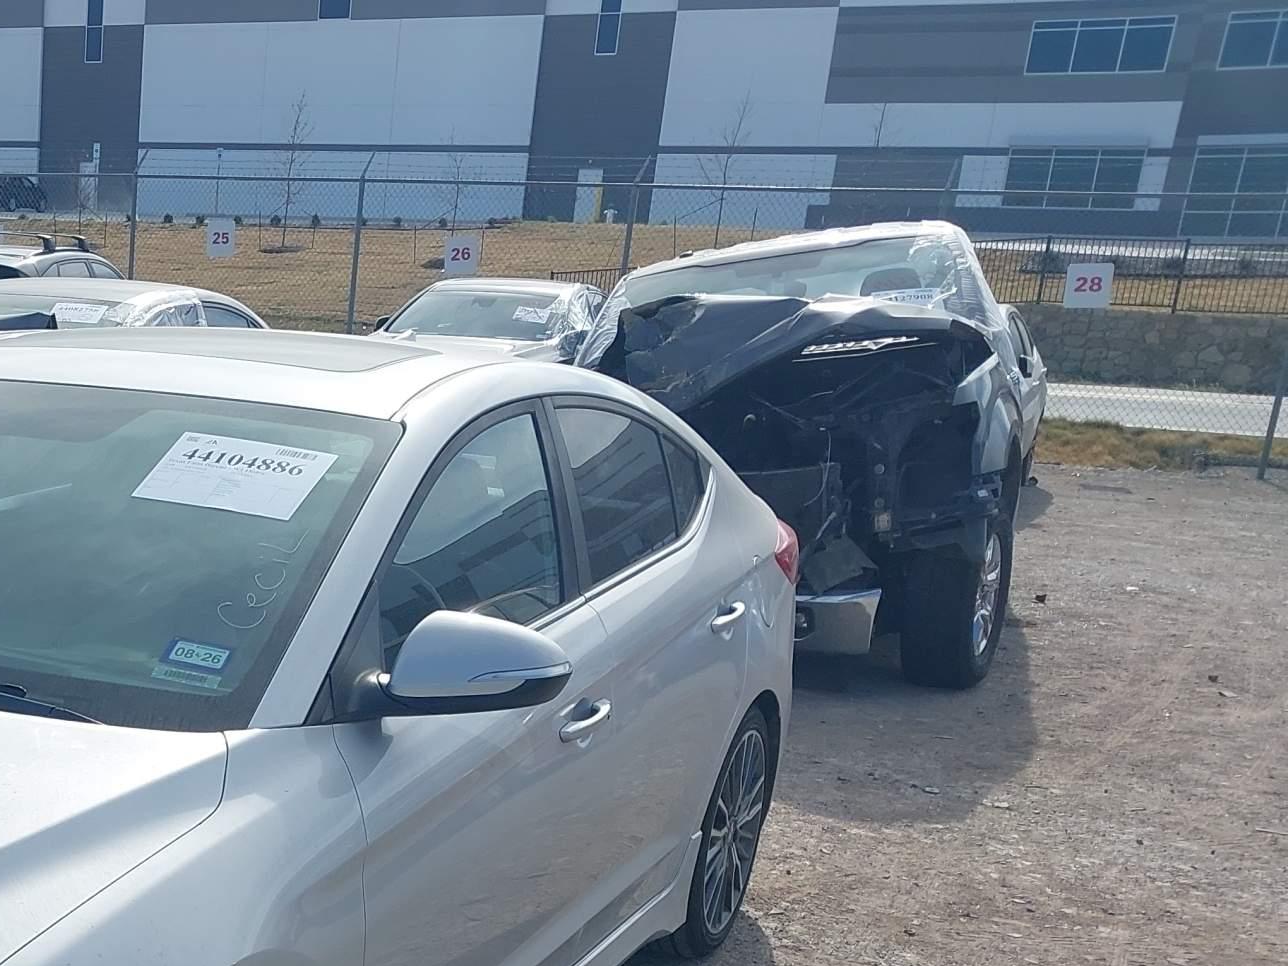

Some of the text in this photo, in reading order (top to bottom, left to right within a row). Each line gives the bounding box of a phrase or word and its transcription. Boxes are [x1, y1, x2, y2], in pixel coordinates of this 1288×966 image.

[212, 231, 230, 245] 25
[450, 247, 471, 261] 26
[1074, 276, 1103, 293] 28
[182, 448, 304, 476] 44104886
[174, 647, 223, 665] 08 26
